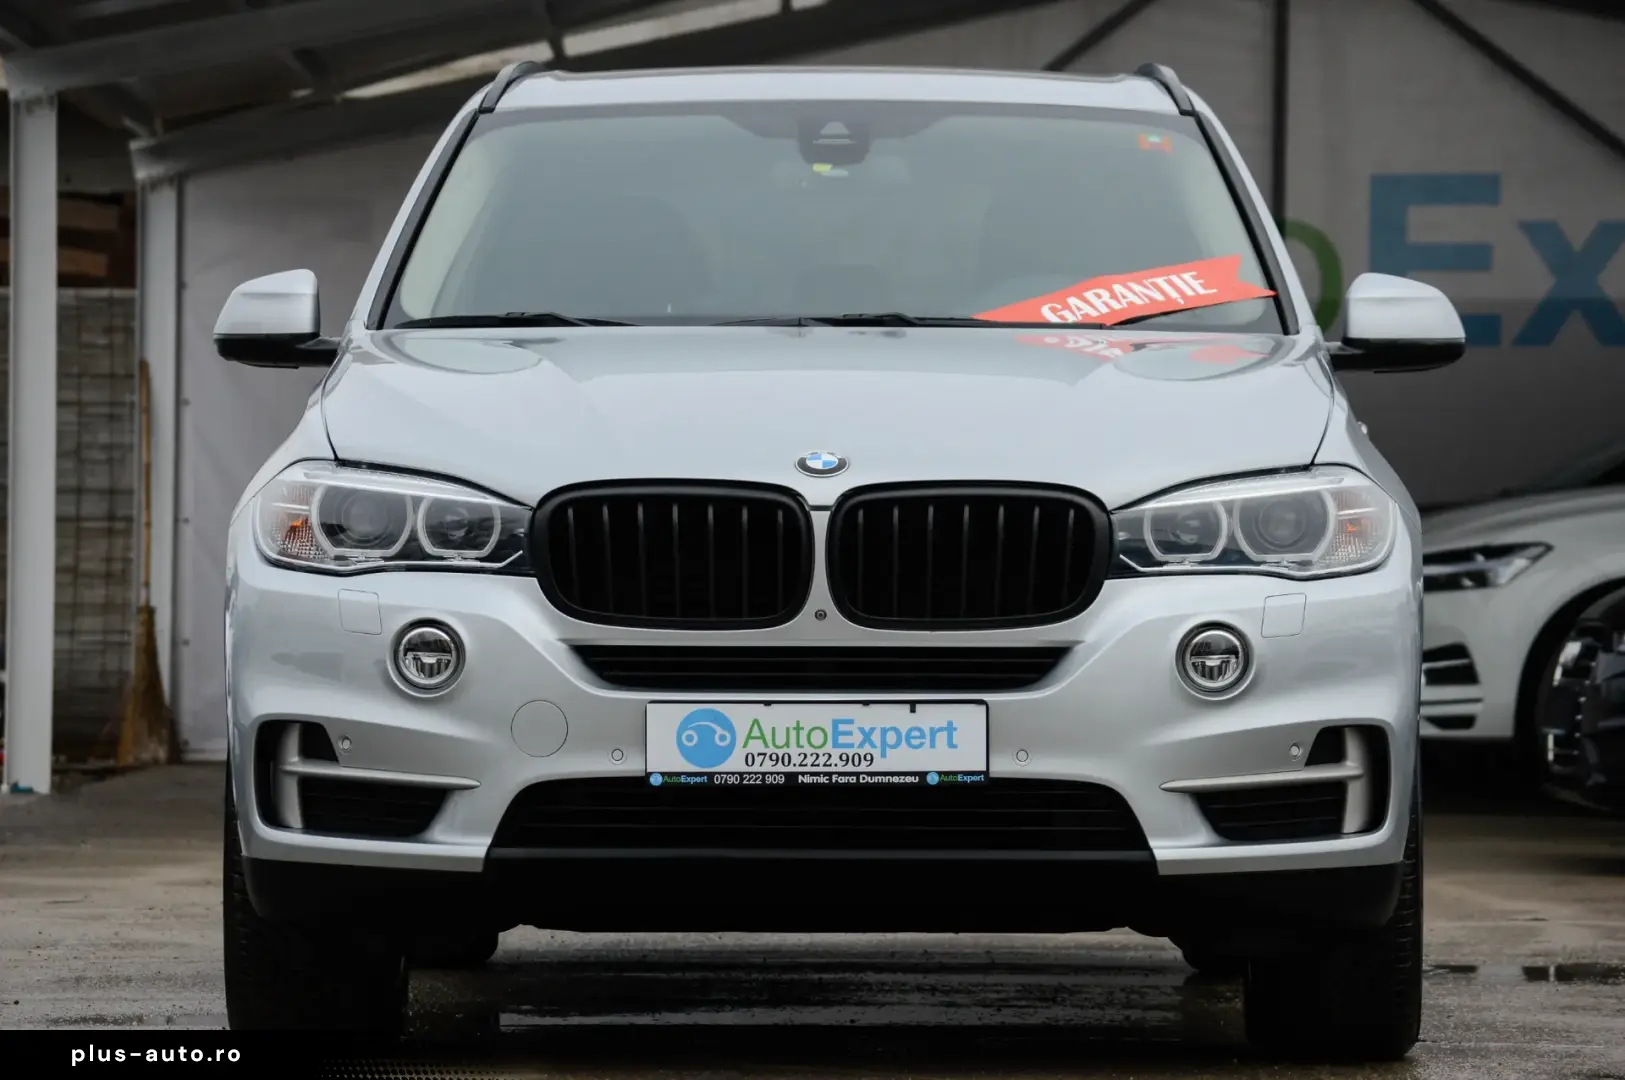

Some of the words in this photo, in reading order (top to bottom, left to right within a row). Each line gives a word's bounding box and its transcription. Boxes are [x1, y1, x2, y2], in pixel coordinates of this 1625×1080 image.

[742, 718, 958, 758] AutoExpert
[744, 752, 874, 767] 0790.222.909
[662, 775, 708, 785] AutoExpert
[713, 774, 740, 784] 0790
[743, 774, 762, 784] 222
[765, 774, 785, 784] 909
[798, 774, 829, 783] Nimic
[832, 774, 857, 783] Fara
[860, 774, 919, 783] Dumnezeu
[940, 774, 985, 783] AutoExpert
